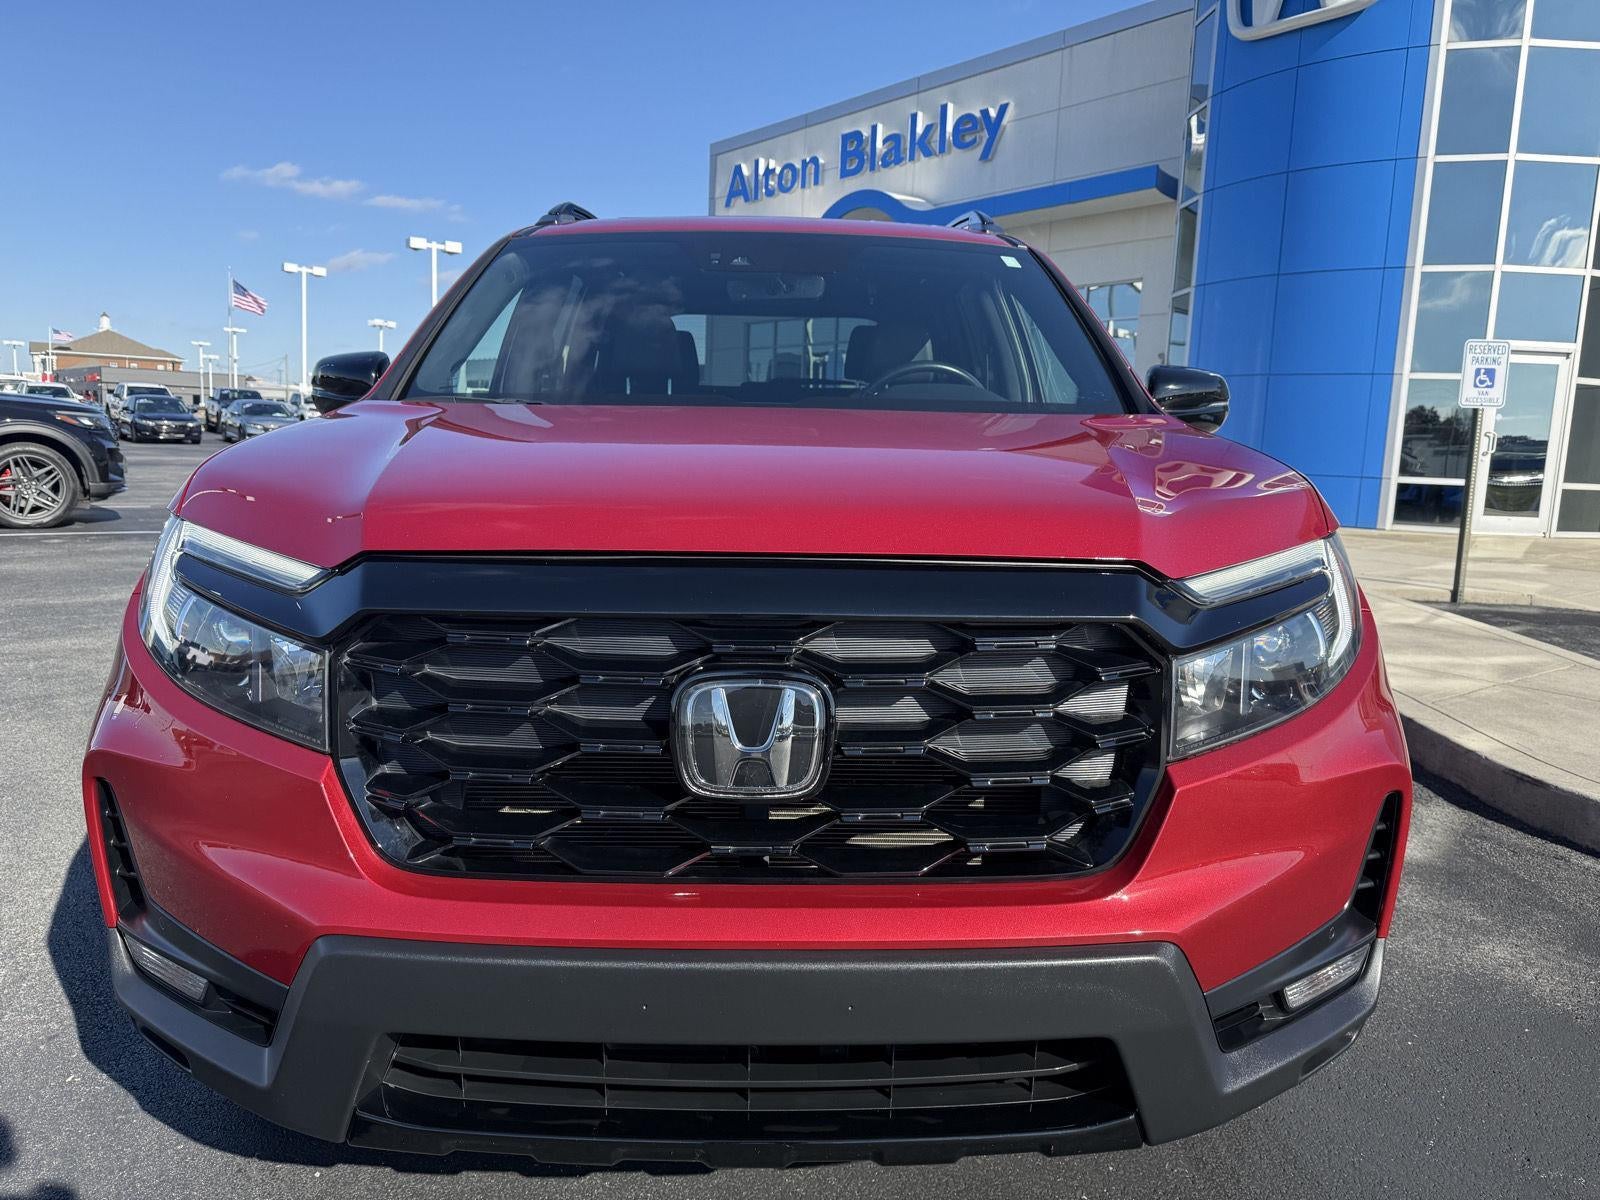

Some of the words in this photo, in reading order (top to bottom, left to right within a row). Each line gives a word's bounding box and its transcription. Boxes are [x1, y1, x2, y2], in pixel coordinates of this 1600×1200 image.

[724, 155, 821, 208] Alton
[839, 101, 1010, 180] Blakley
[1468, 344, 1507, 355] RESERVED
[1471, 356, 1502, 366] PARKING
